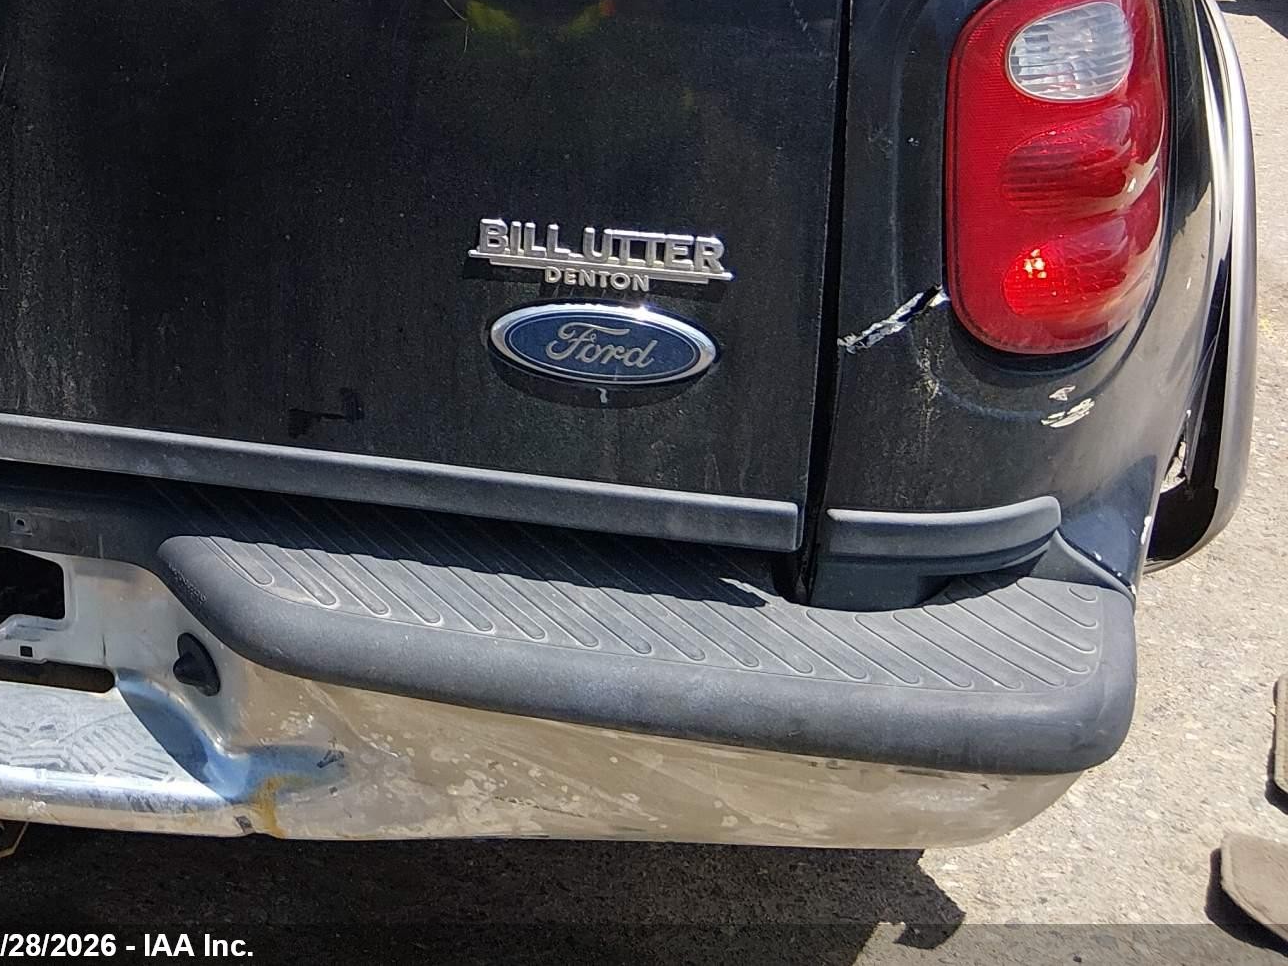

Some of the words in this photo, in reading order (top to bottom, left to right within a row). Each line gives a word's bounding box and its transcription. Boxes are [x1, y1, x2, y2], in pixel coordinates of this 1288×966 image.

[478, 218, 572, 258] BILL
[582, 227, 726, 274] UTTER
[543, 266, 650, 292] DENTON
[545, 321, 660, 368] Ford
